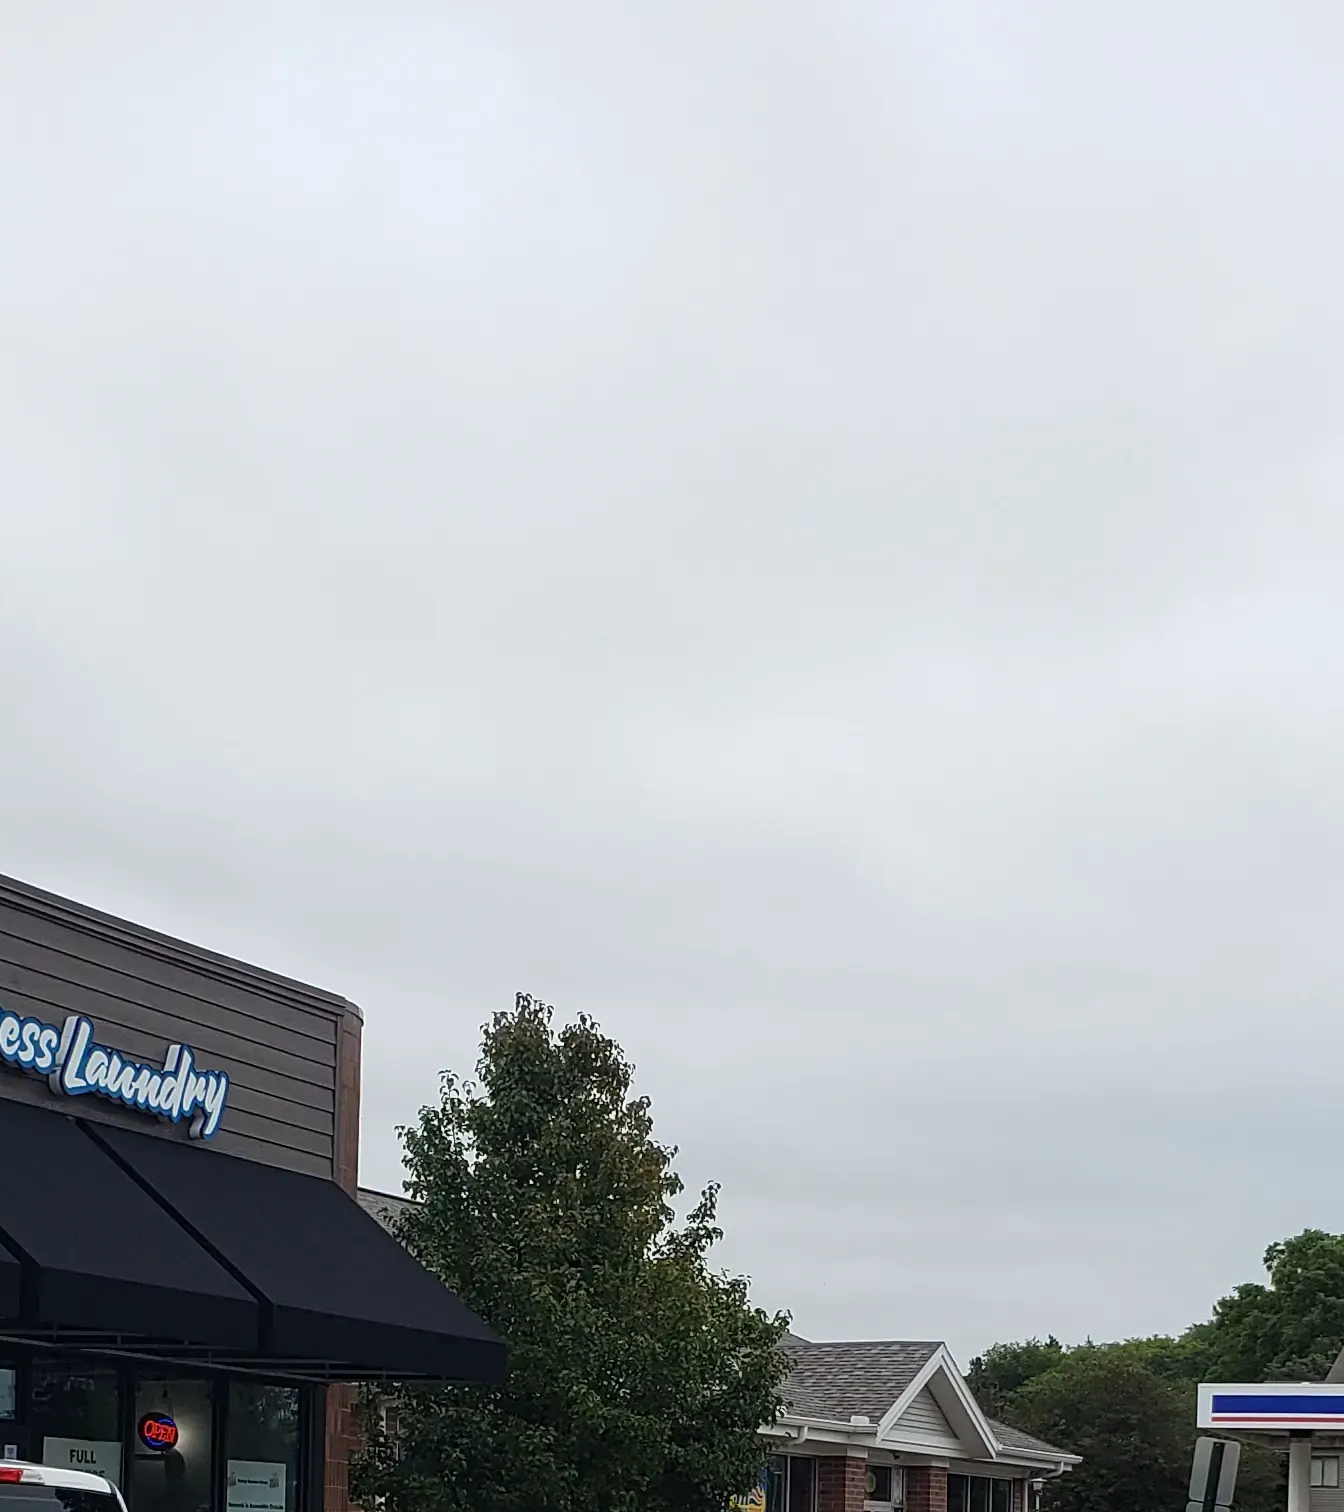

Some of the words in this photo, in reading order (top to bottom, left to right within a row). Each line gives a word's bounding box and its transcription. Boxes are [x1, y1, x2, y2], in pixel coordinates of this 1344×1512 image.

[60, 1017, 230, 1139] Laundry
[144, 1420, 176, 1443] OPEN
[69, 1449, 97, 1464] FULL
